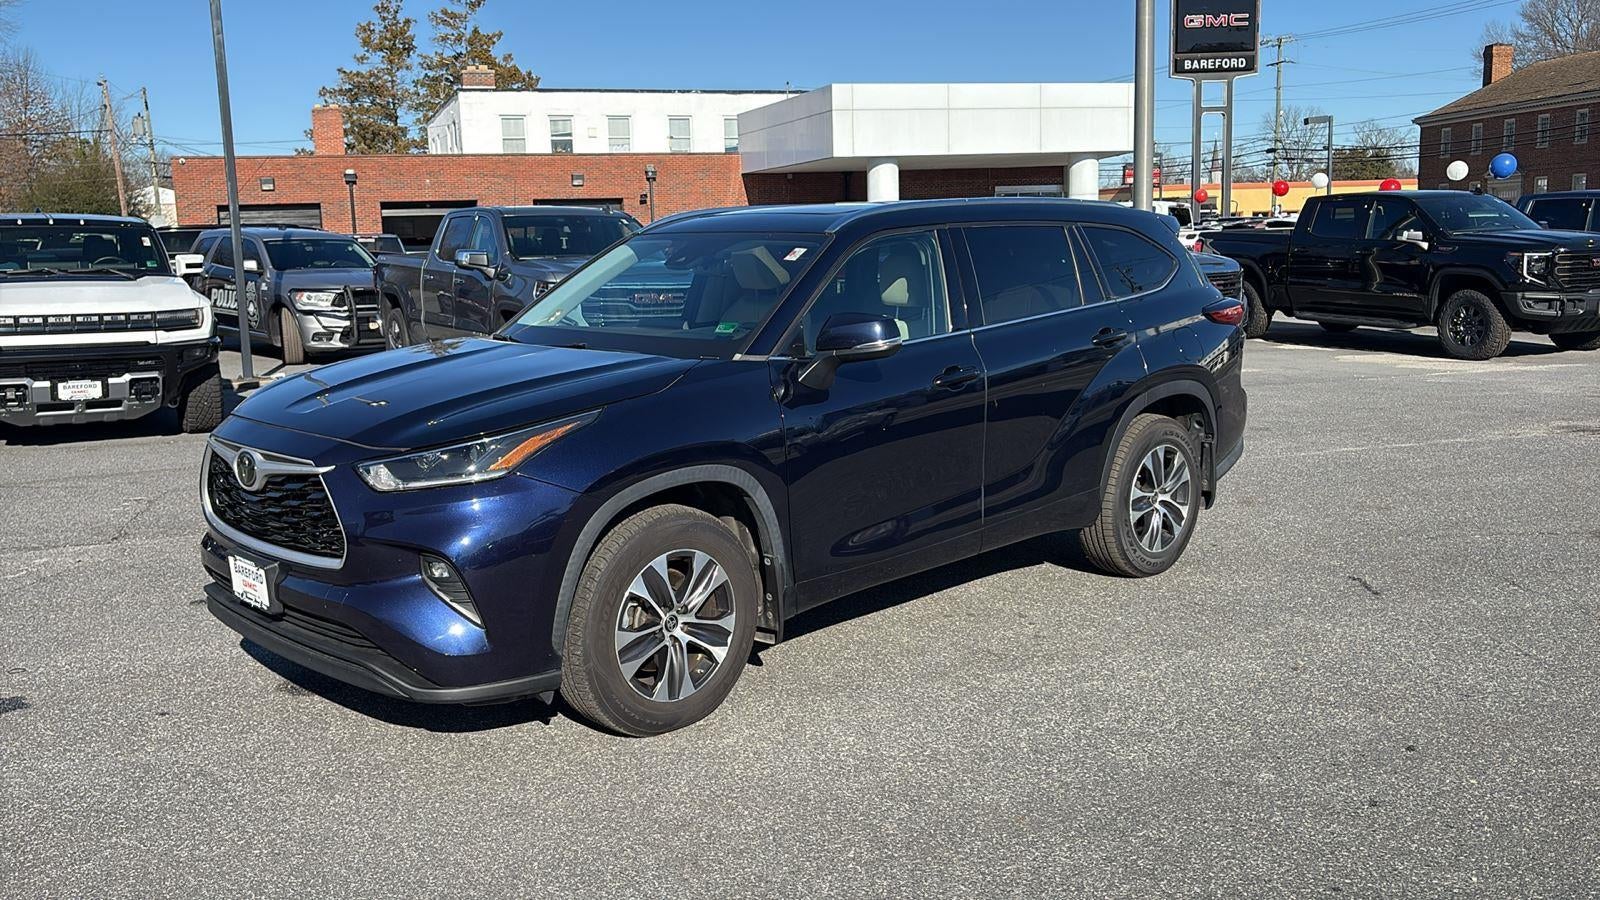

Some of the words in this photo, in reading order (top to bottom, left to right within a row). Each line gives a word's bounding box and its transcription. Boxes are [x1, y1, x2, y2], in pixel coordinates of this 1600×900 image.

[1184, 13, 1249, 28] GMC
[1184, 58, 1246, 69] BAREFORD
[211, 288, 238, 309] POLIC
[234, 562, 264, 584] BAREFORD
